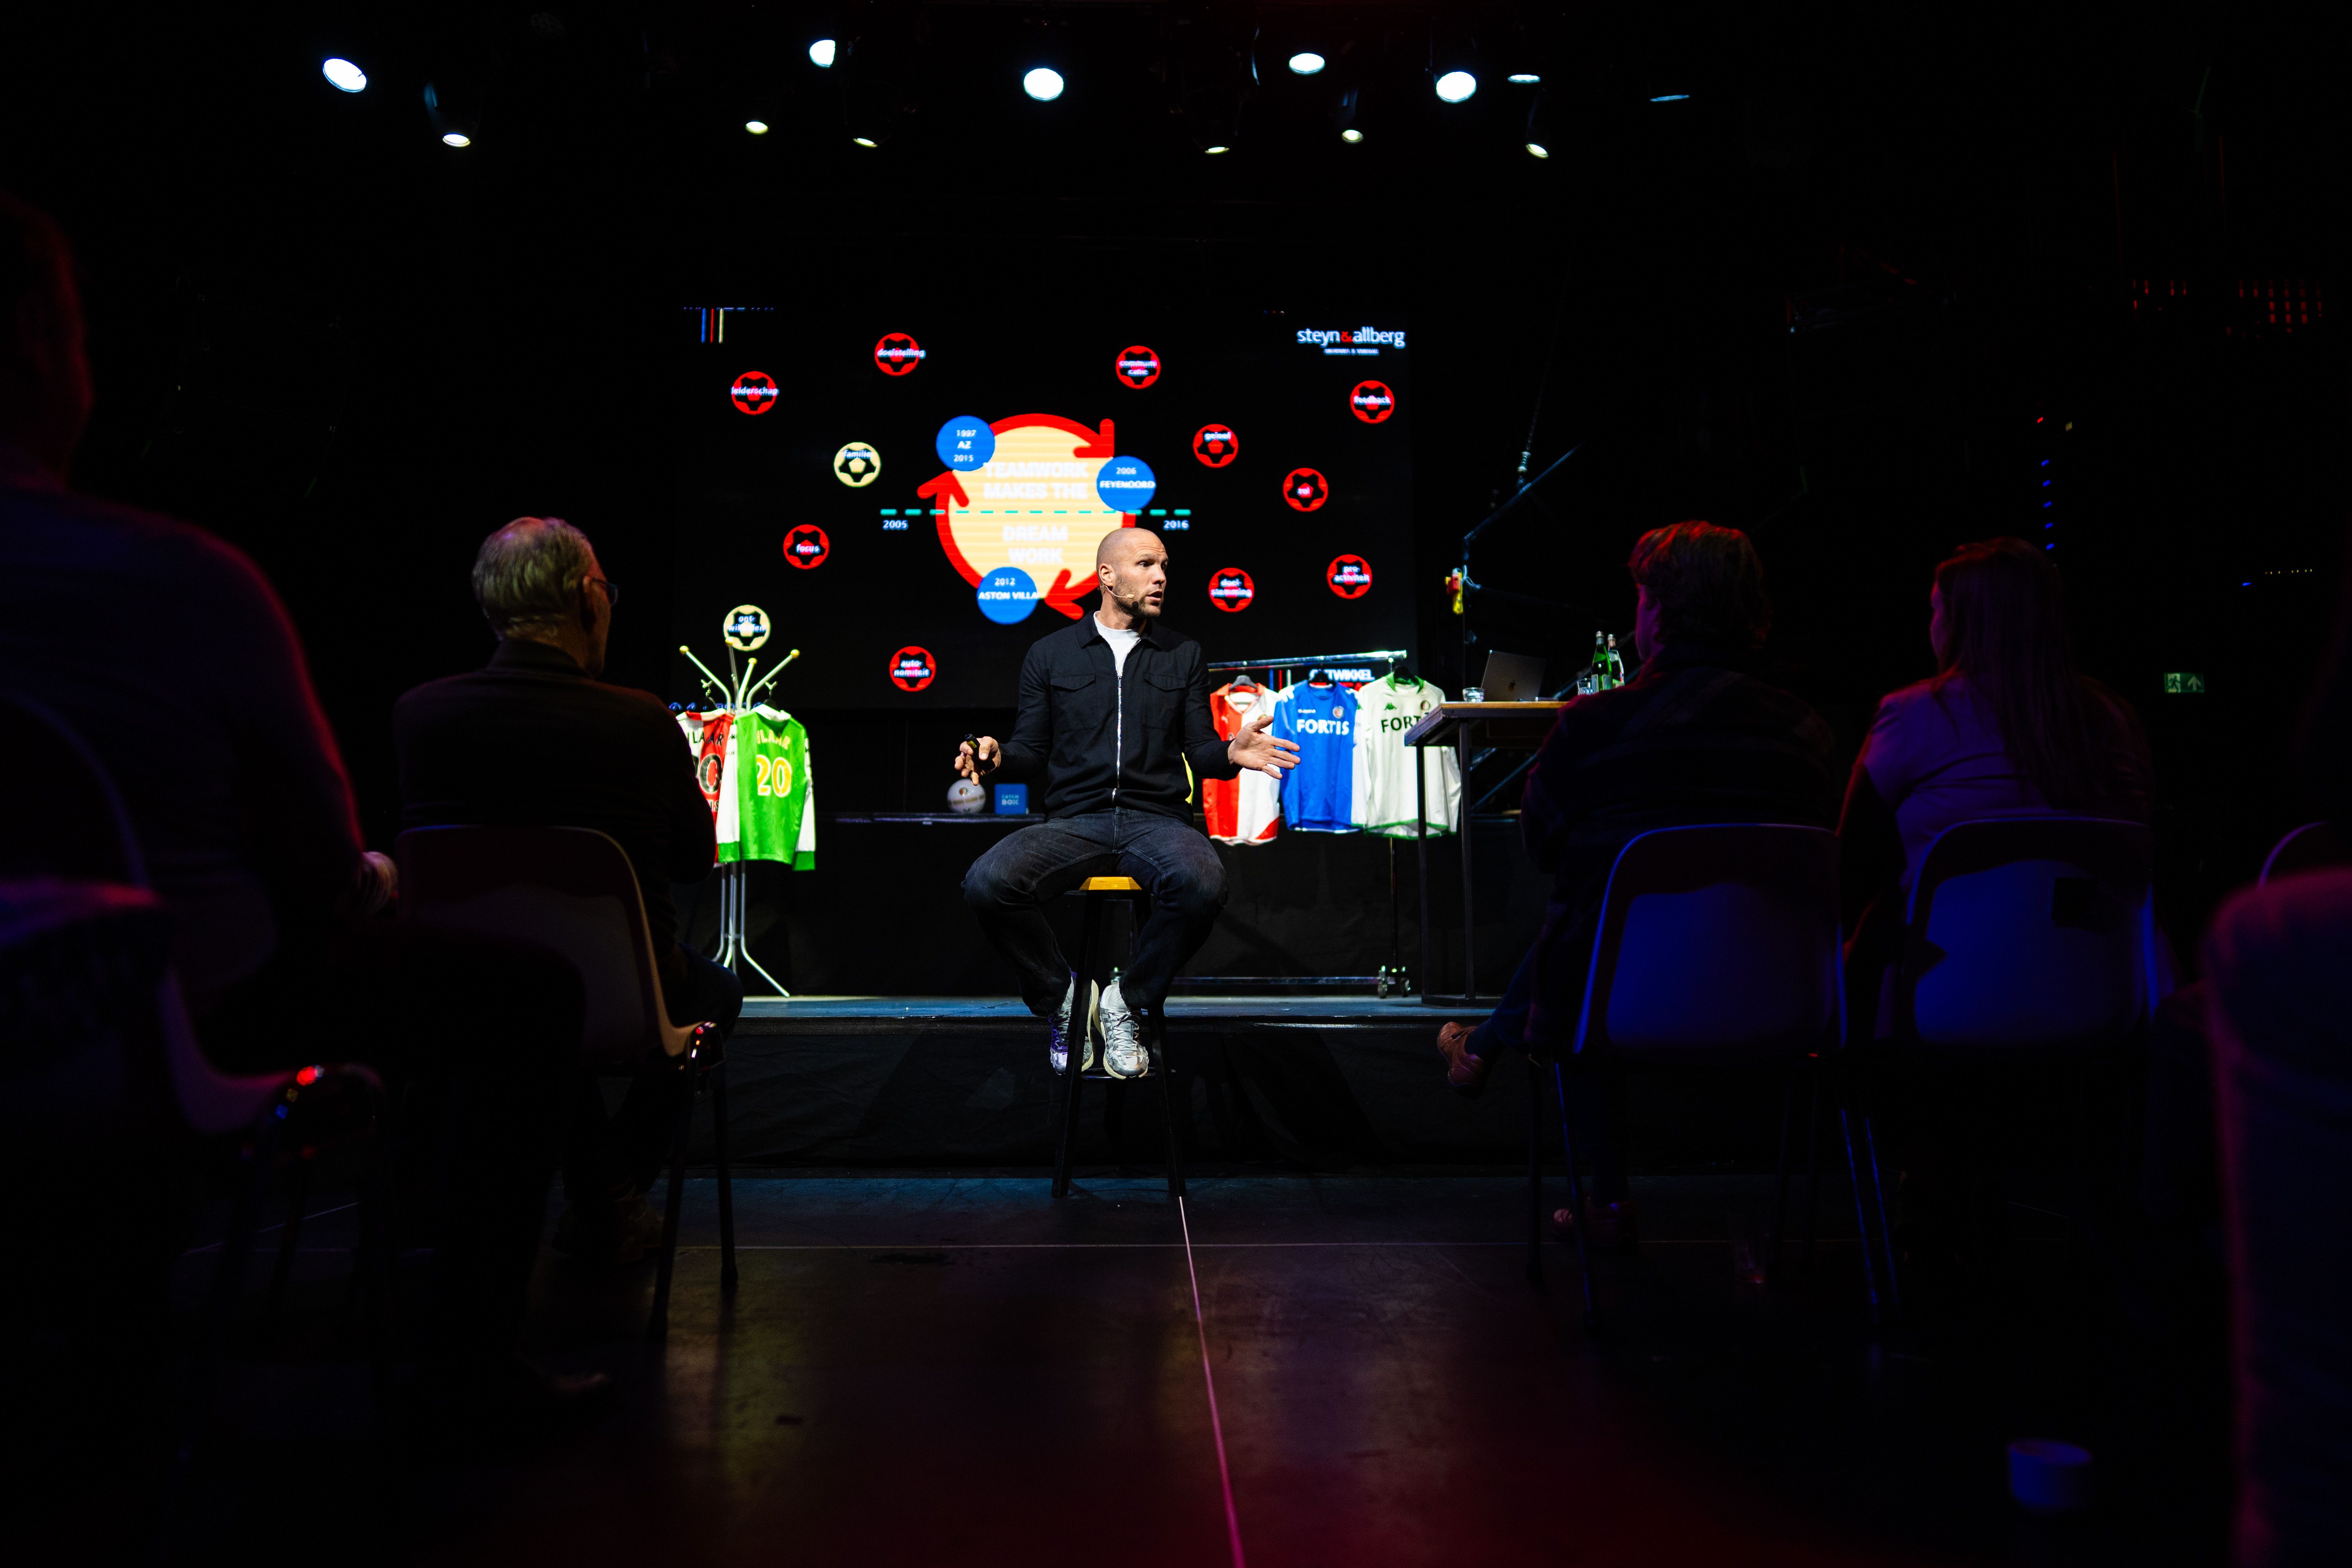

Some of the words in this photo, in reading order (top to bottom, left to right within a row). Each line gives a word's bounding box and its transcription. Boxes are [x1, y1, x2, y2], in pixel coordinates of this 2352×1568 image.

[877, 348, 926, 359] doelstelling
[731, 386, 779, 396] leiderschap
[1353, 395, 1391, 405] feedback
[956, 429, 976, 437] 1997
[1204, 432, 1232, 442] geloof
[957, 440, 972, 449] AZ
[843, 449, 872, 459] familie
[953, 454, 974, 462] 2015
[983, 461, 1088, 477] TEAMWORK
[1116, 467, 1137, 475] 2006
[1099, 480, 1156, 488] FEYENOORD
[984, 482, 1048, 498] MAKES
[1050, 482, 1088, 499] THE
[882, 519, 909, 530] 2005
[1163, 520, 1190, 530] 2016
[1002, 525, 1068, 541] DREAM
[796, 543, 820, 553] focus
[1007, 547, 1063, 563] WORK
[995, 578, 1015, 586] 2012
[978, 592, 1011, 600] ASTON
[1309, 669, 1375, 681] OTWIKKEL
[1297, 719, 1349, 735] FORTIS
[756, 754, 792, 798] 20
